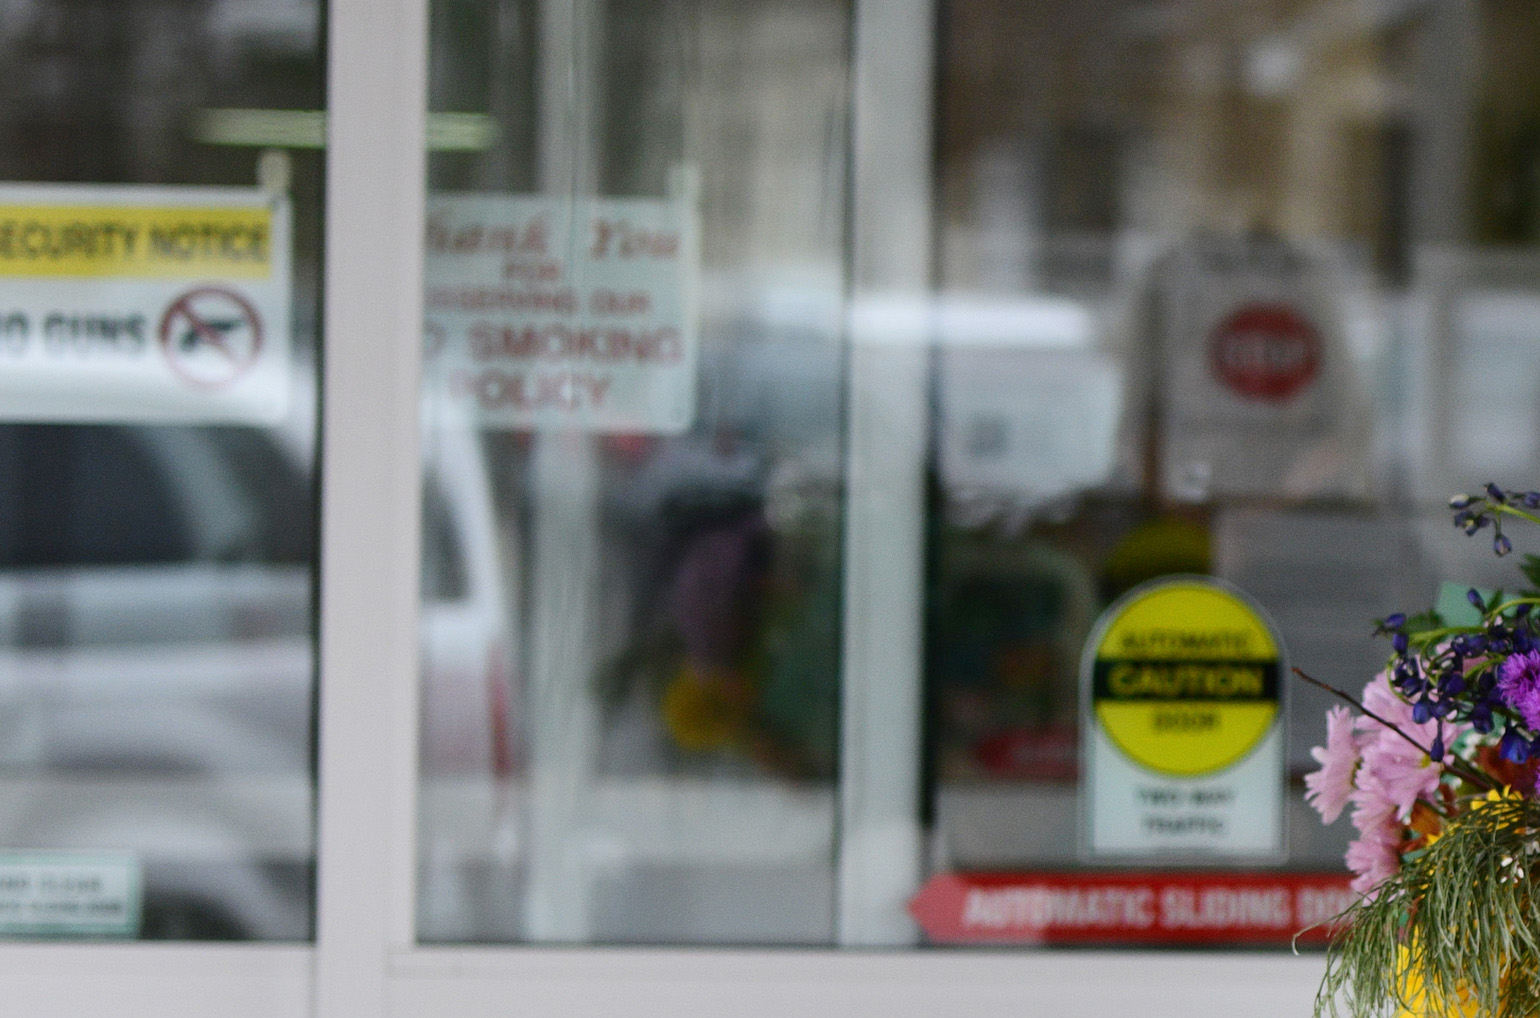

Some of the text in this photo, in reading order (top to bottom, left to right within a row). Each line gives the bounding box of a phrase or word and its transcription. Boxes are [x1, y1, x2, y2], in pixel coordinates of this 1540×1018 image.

[0, 219, 268, 263] ECURITY NOTICE
[0, 311, 146, 355] O GUNS
[470, 322, 685, 367] SMOKING
[451, 371, 611, 411] POLICY
[1107, 664, 1266, 697] CAUTION
[963, 886, 1156, 930] AUTOMATIC
[1159, 886, 1292, 930] SLIDING
